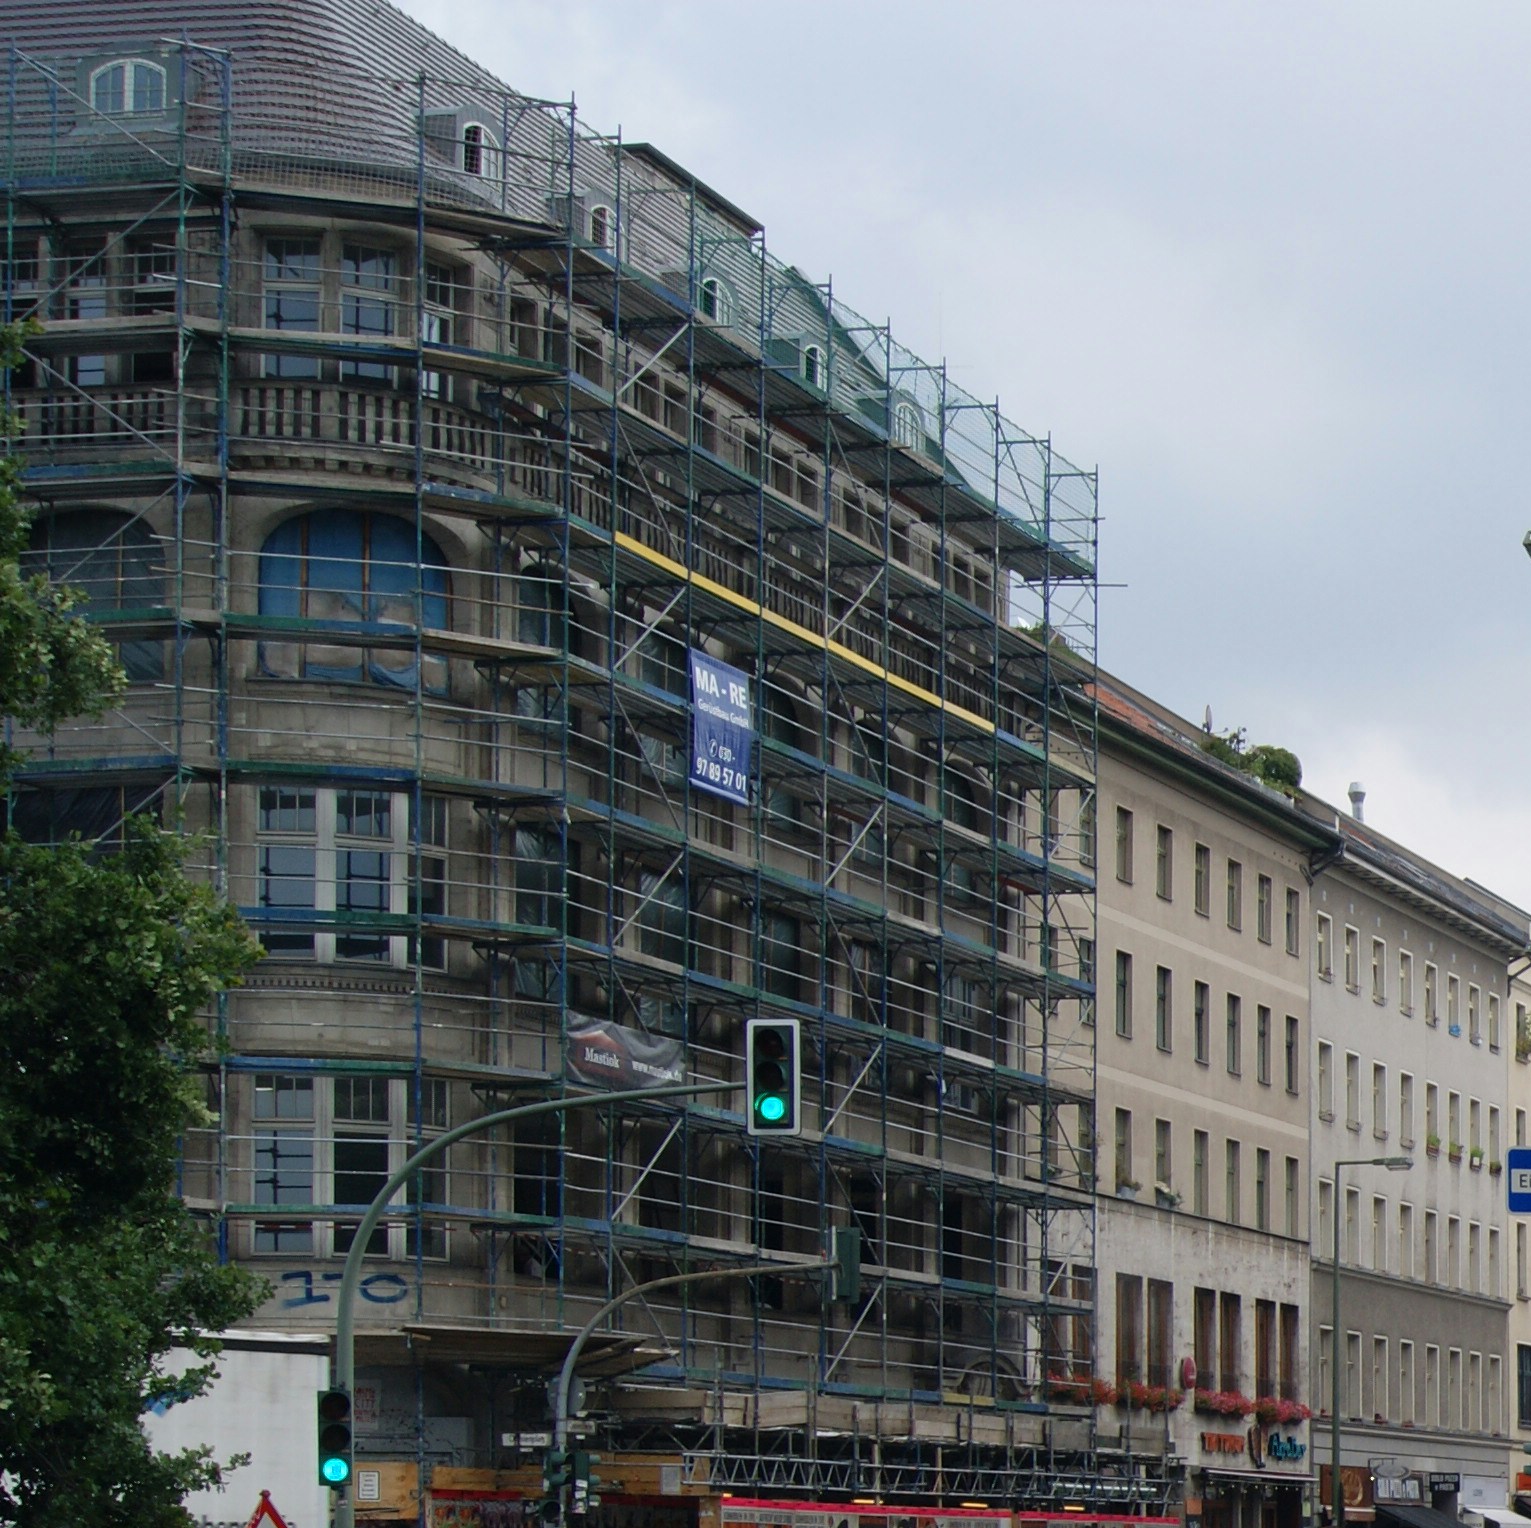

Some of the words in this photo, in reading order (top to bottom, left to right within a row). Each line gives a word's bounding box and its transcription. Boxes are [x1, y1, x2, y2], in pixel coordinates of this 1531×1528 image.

[695, 666, 720, 698] MA
[728, 682, 748, 709] RE
[695, 757, 707, 775] 97
[708, 763, 721, 783] 89
[722, 768, 734, 788] 57
[735, 773, 747, 793] 01
